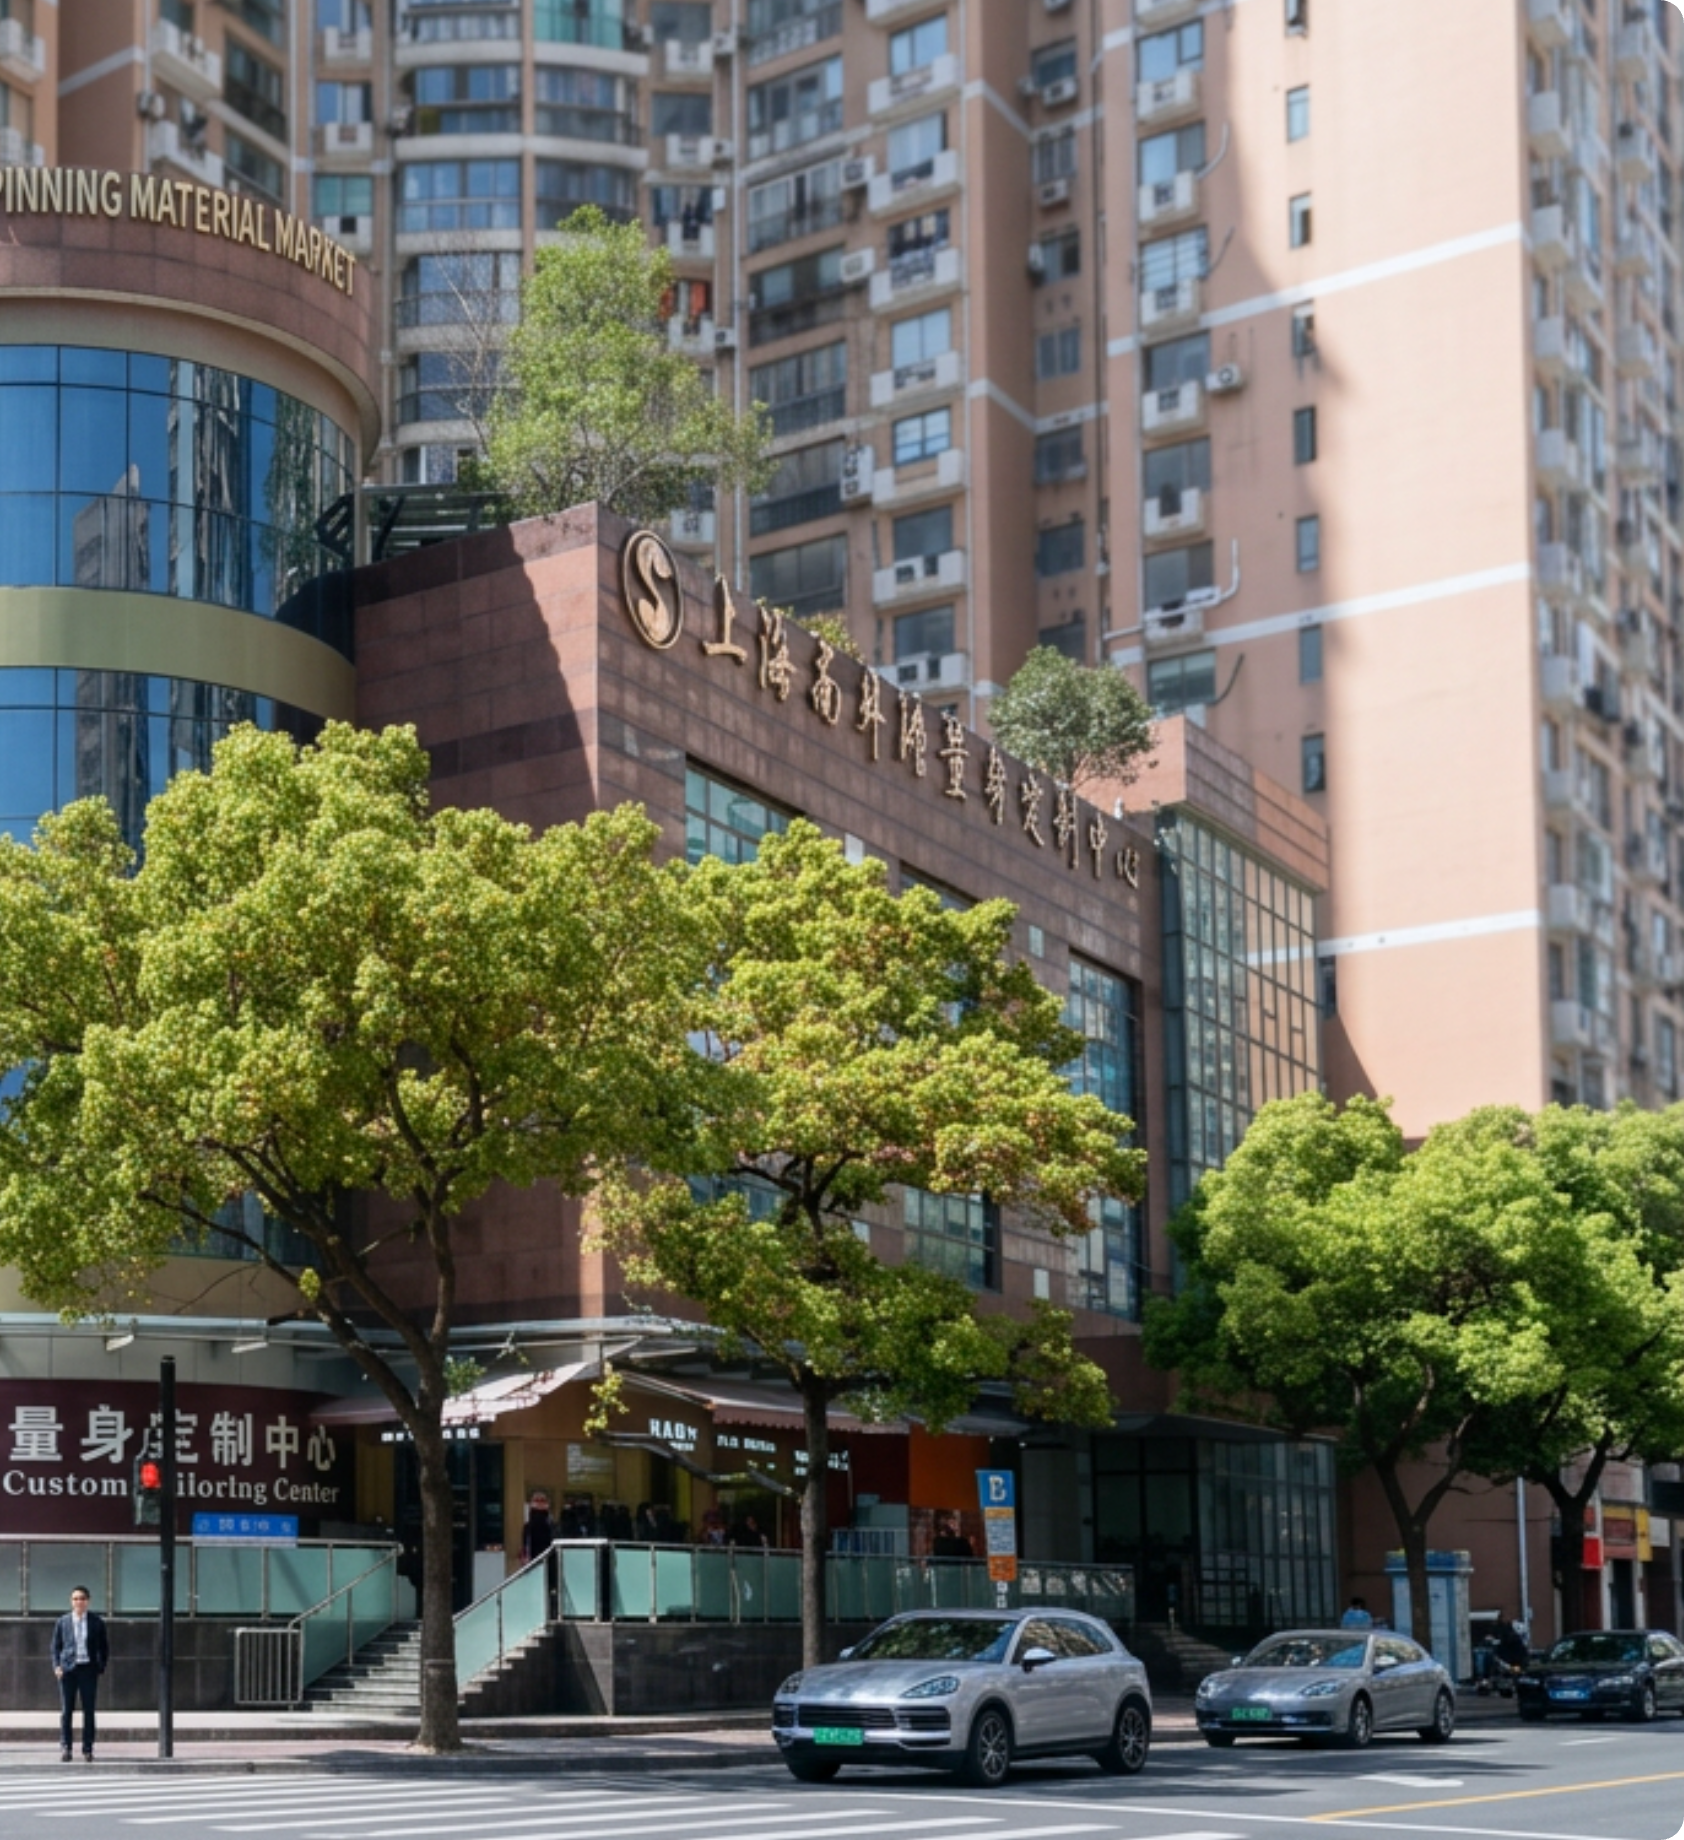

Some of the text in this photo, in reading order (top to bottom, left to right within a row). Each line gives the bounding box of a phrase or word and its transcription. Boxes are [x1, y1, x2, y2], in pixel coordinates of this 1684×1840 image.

[130, 174, 270, 251] MATERIAL
[275, 209, 356, 296] MARKET
[3, 1470, 129, 1496] Custom
[176, 1472, 268, 1506] iloring
[273, 1477, 339, 1504] Center
